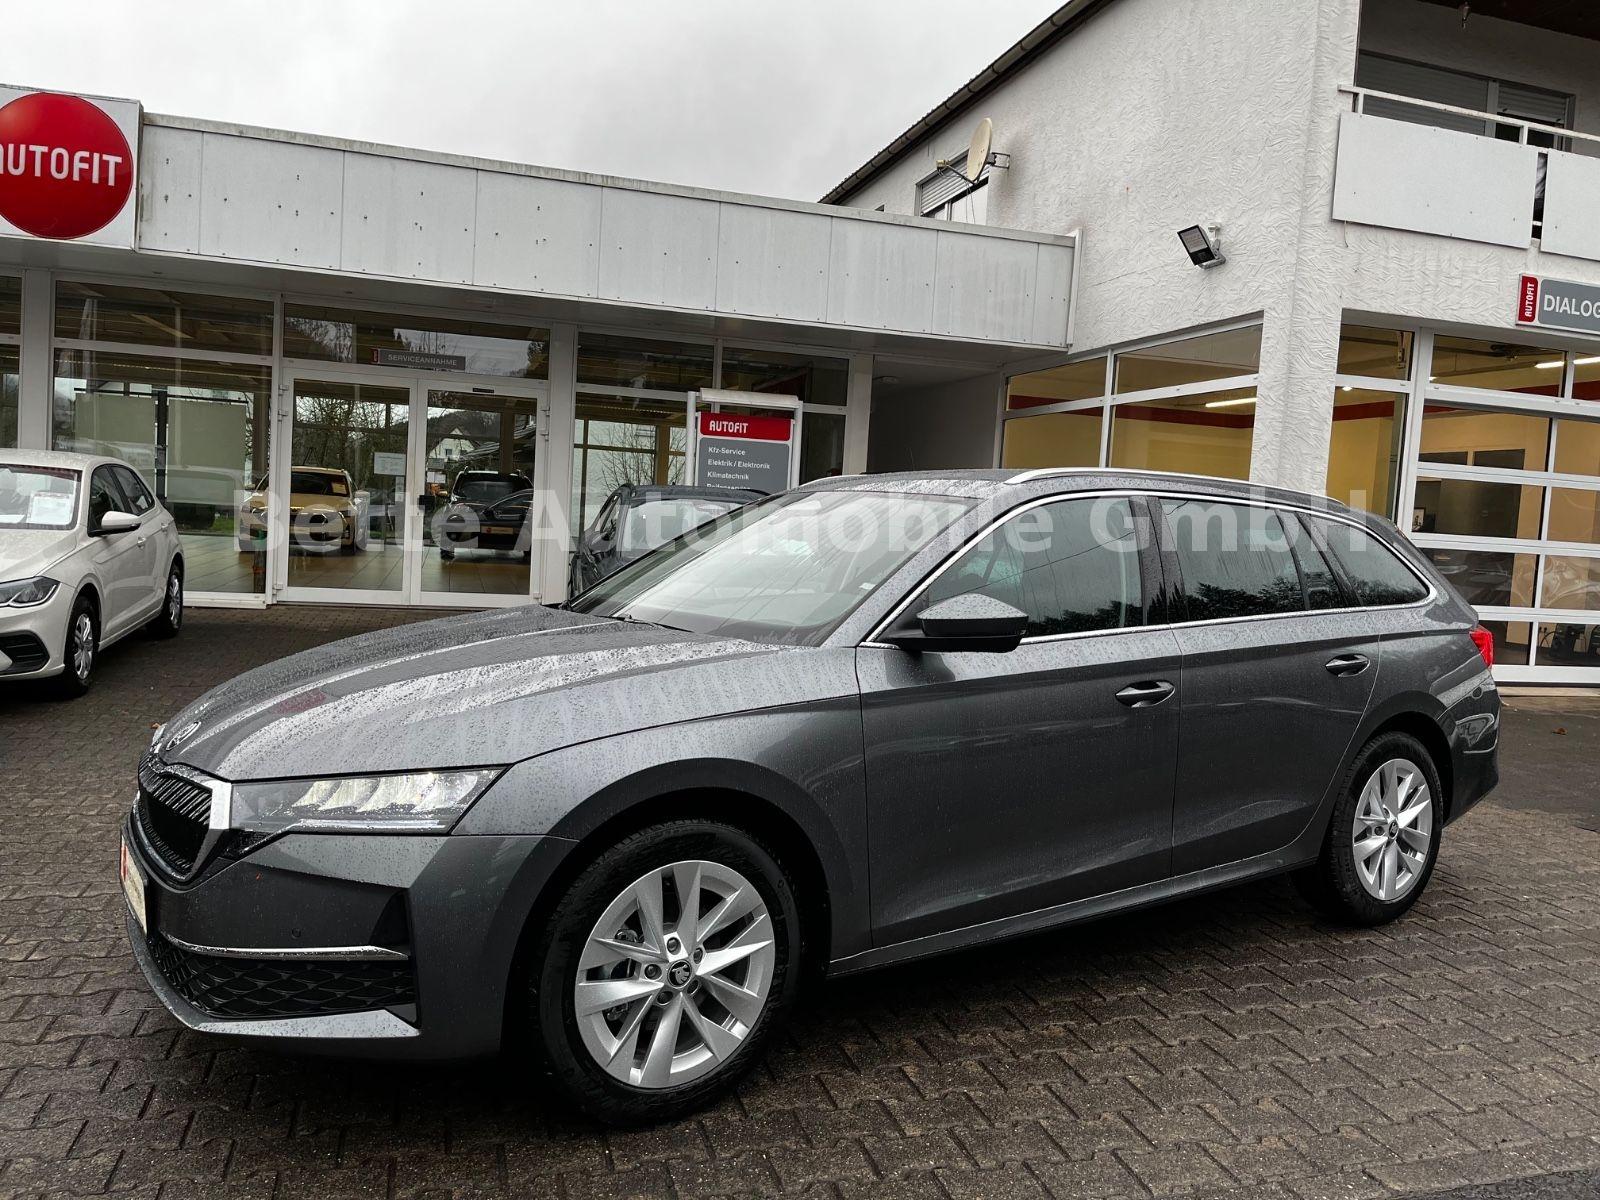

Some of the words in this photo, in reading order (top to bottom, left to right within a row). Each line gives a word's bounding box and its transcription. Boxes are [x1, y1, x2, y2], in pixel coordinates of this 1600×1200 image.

[1524, 282, 1535, 317] AUTOFIT
[387, 353, 457, 366] SERVICEANNAHME
[709, 420, 749, 434] AUTOFIT
[708, 446, 746, 456] Kfz-Service
[737, 461, 771, 470] Elektronik
[707, 471, 749, 481] Klimatechnik
